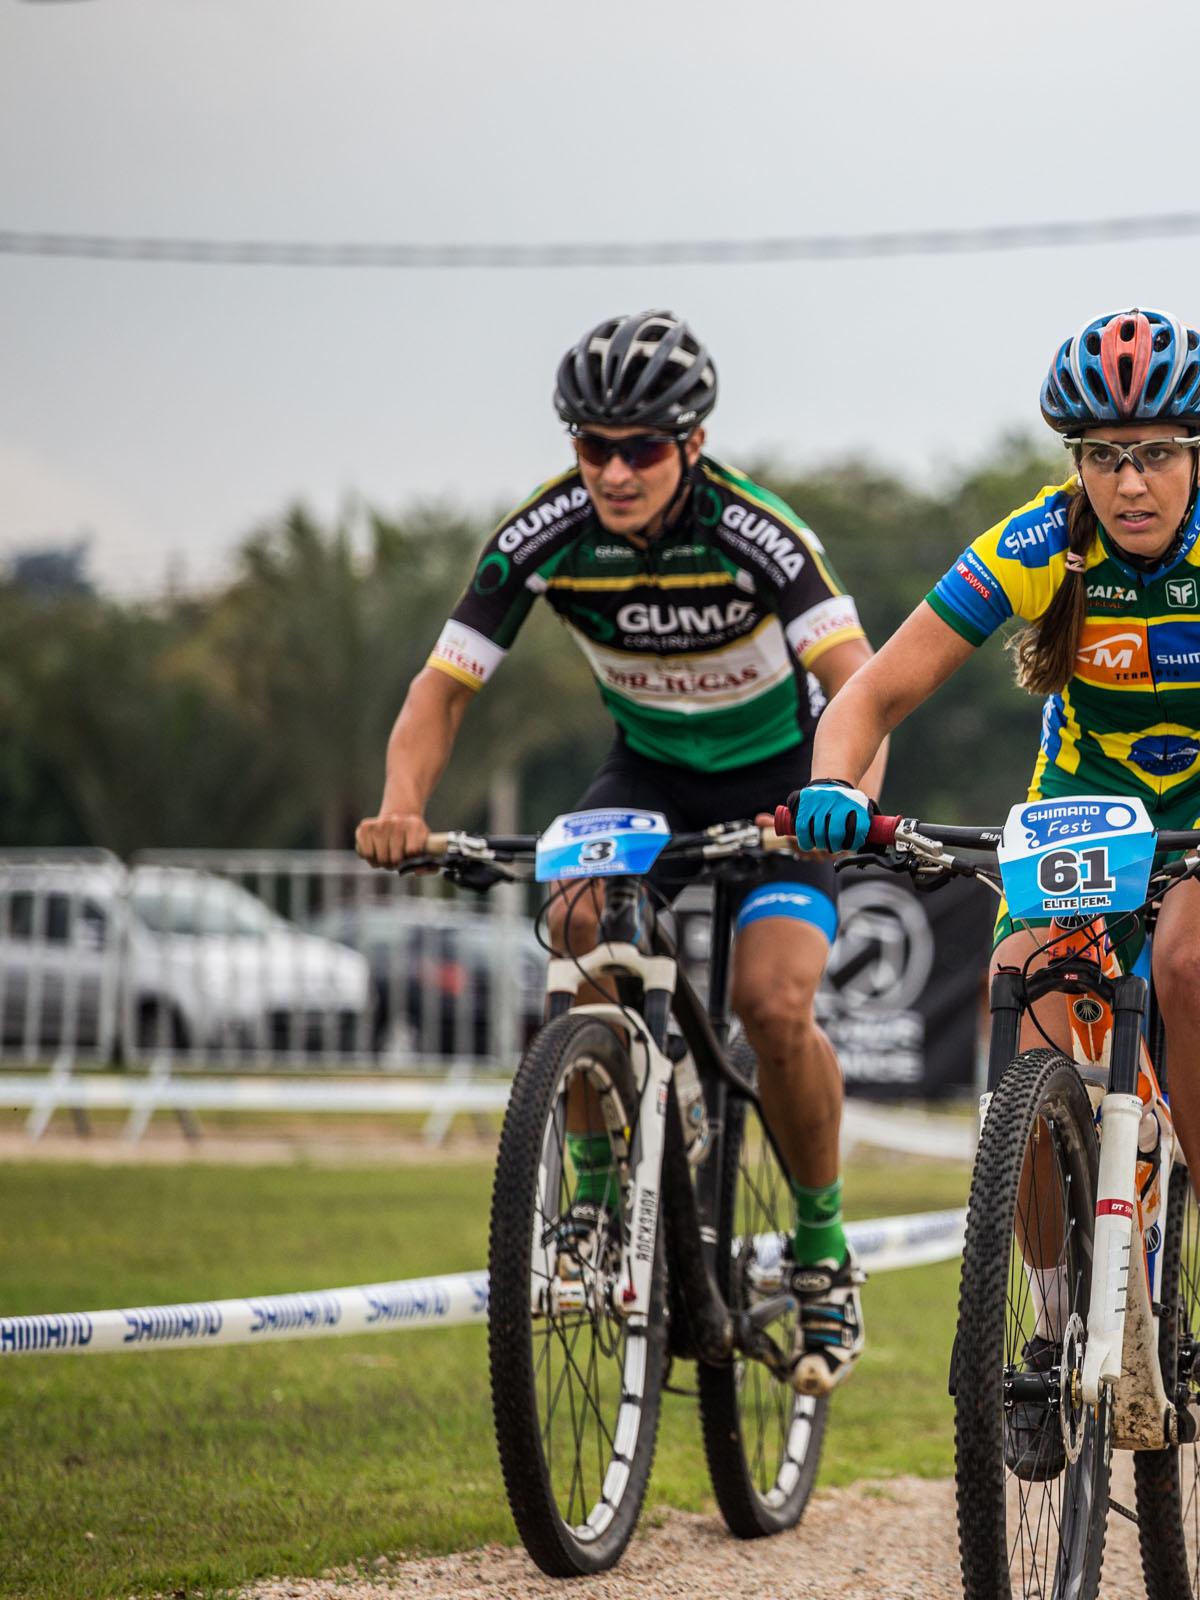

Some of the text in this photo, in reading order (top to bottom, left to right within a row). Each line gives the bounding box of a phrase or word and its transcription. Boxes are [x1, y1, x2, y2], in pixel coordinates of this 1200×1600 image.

[498, 487, 588, 553] GUMA
[722, 504, 805, 581] GUMA
[1086, 584, 1138, 601] CAIXA
[616, 600, 753, 634] GUMA
[1027, 805, 1100, 823] SHIMANO
[1047, 819, 1092, 837] Fest
[578, 837, 618, 866] 3
[1037, 846, 1116, 895] 61
[1044, 896, 1111, 909] ELITE FEM.
